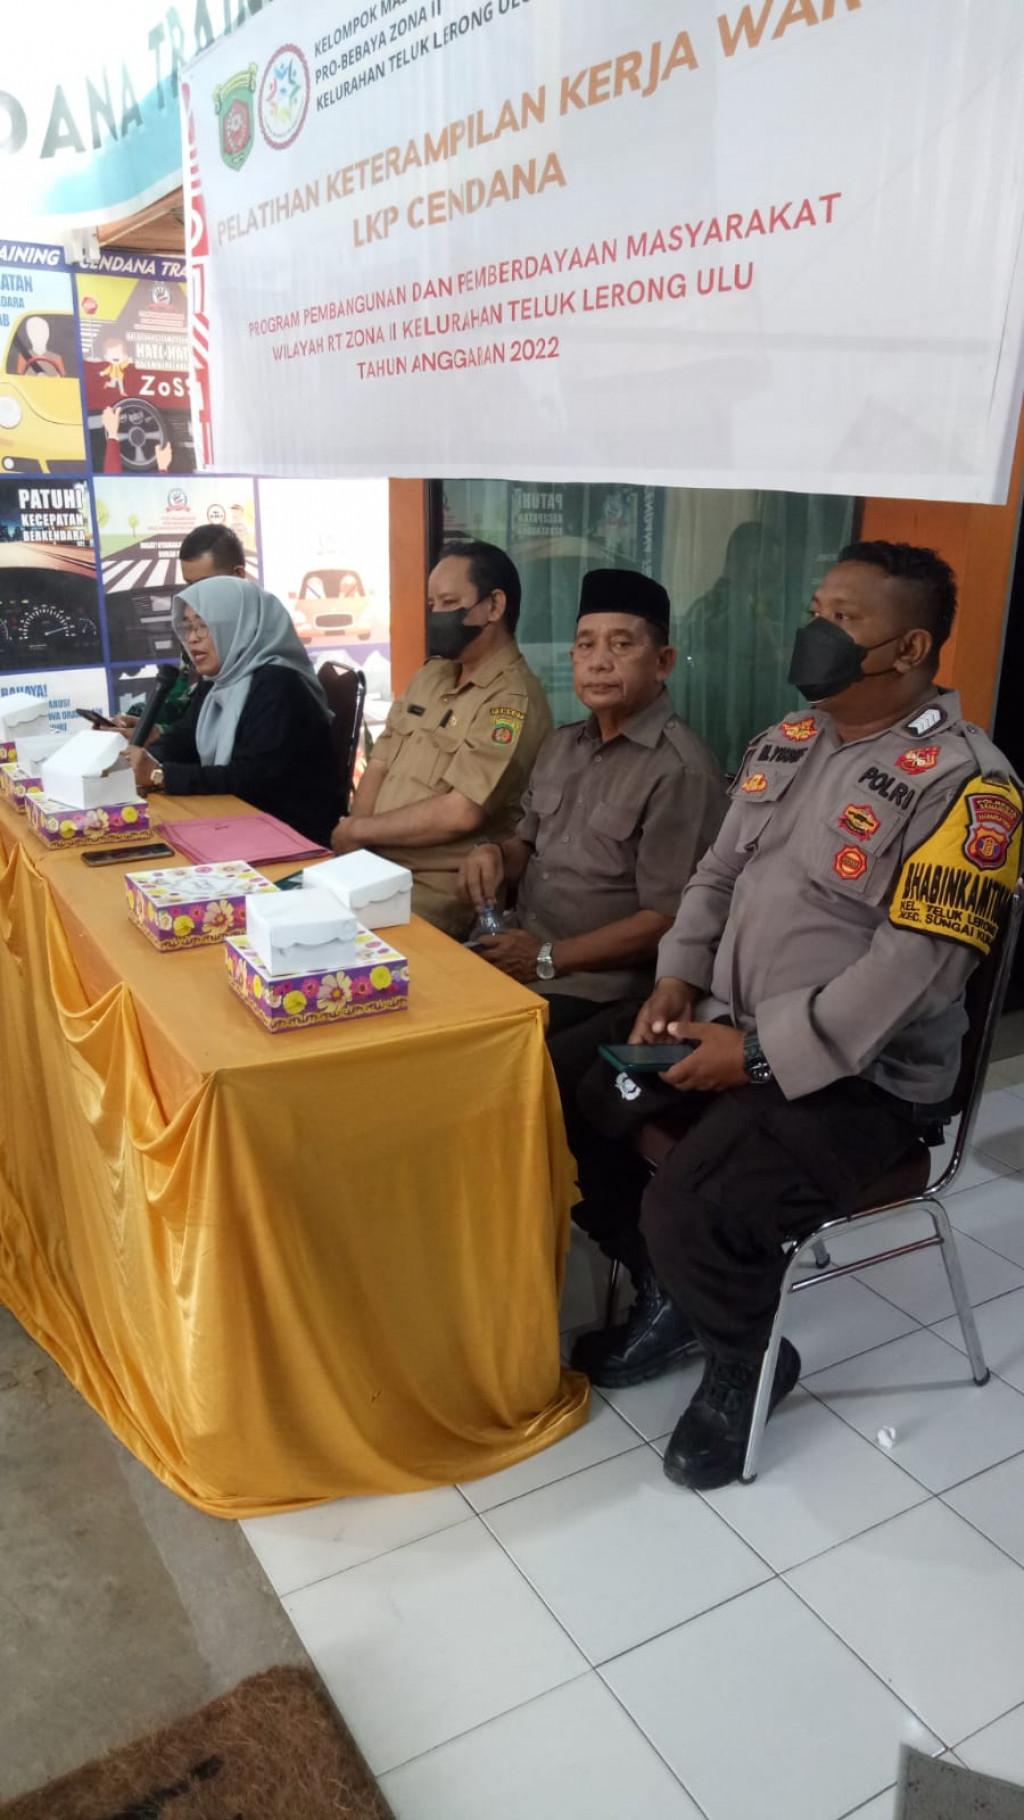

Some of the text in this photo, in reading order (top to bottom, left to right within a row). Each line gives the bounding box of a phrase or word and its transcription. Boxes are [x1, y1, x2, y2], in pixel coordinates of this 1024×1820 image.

[314, 0, 407, 58] KELOMPOK MA
[315, 0, 442, 84] PRO-BEBAYA ZONA II
[316, 0, 531, 111] KELURAHAN TELUK LERONG UL
[217, 180, 321, 246] PELATIHAN
[326, 84, 546, 203] KETERAMPILAN
[559, 30, 699, 116] KERJA
[352, 152, 568, 248] LKP CENDANA
[249, 192, 842, 337] PROGRAM PEMBANGUNAN DAN PEMBERDAYAAN MASYARAKAT
[272, 262, 754, 361] WILAYAH RT ZONA II KELURAHAN TELUK LERONG ULU
[356, 336, 560, 380] TAHUN ANGGARAN 2022
[18, 488, 84, 510] PATUHI
[21, 513, 84, 527] KECEPATAN
[858, 767, 915, 810] POLRI
[925, 914, 974, 938] SUNGAI
[927, 905, 963, 922] TELUK
